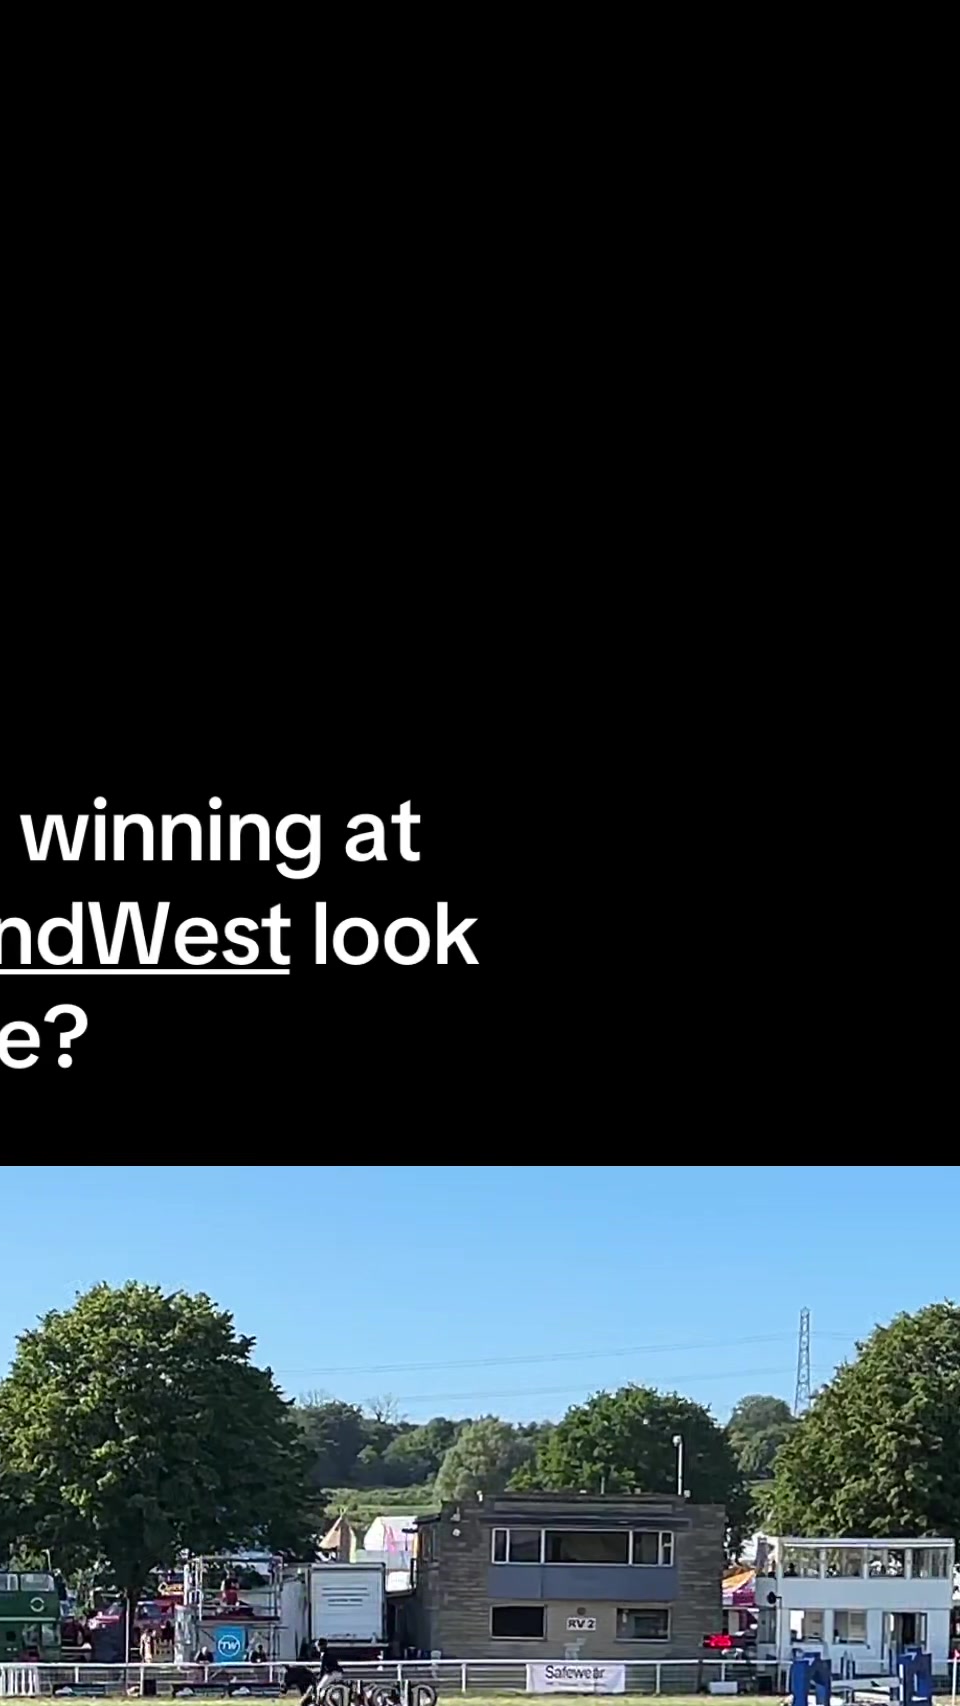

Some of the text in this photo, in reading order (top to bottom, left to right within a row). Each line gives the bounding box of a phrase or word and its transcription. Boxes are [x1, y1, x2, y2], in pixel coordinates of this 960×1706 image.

[568, 1619, 595, 1629] RV 2
[545, 1664, 605, 1679] Safewear
